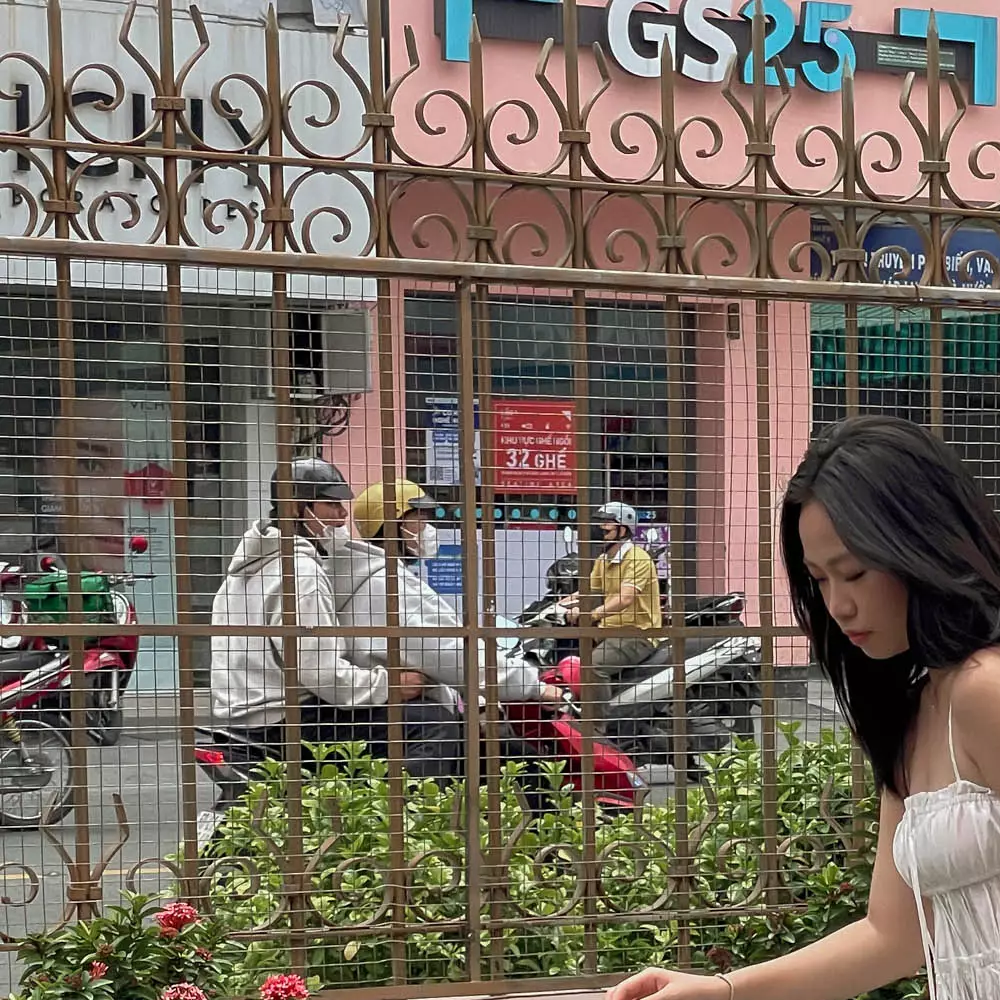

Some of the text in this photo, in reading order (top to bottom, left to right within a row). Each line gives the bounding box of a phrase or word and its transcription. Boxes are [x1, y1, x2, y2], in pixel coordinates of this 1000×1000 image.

[607, 0, 857, 93] GS25
[506, 446, 567, 469] 32 GHẾ
